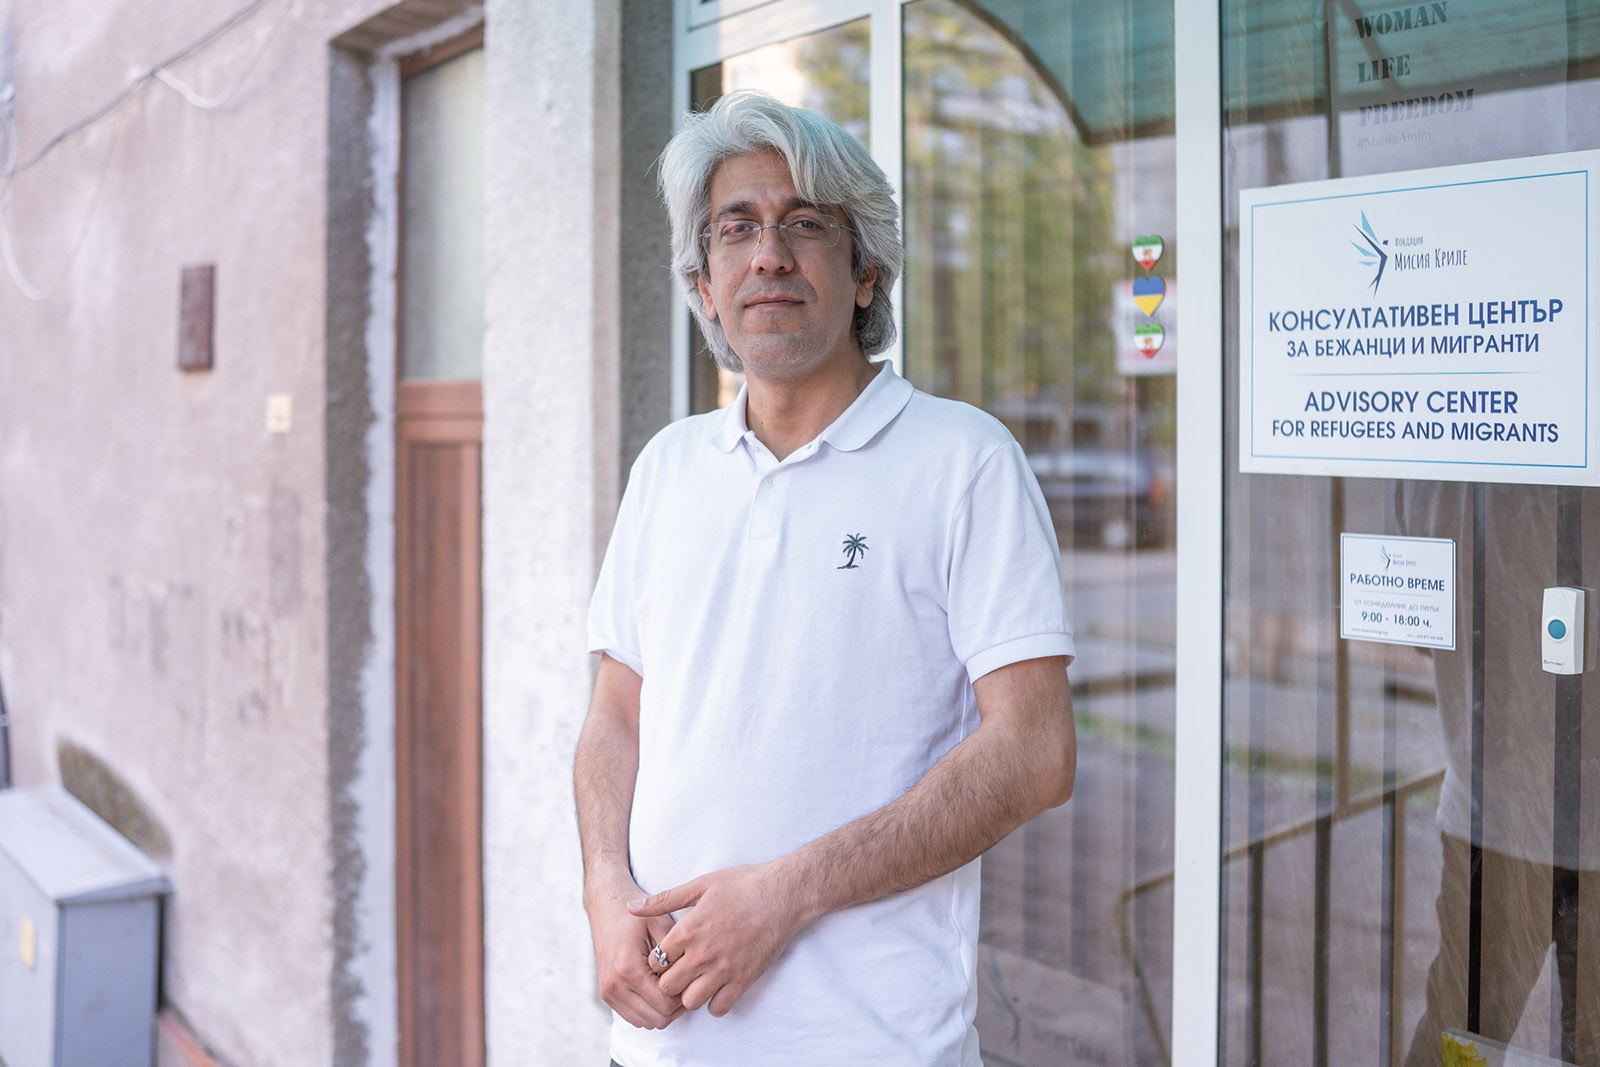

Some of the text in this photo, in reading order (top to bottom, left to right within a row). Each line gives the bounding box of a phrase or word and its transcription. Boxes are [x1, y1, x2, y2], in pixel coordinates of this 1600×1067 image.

[1355, 2, 1448, 39] WOMAN
[1357, 54, 1410, 83] LIFE
[1359, 89, 1475, 127] FREEDOM
[1269, 298, 1563, 331] КОНСУЛТАТИВЕН ЦЕНТЪР
[1287, 334, 1539, 358] ЗА БЕЖАНЦИ И МИГРАНТИ
[1304, 390, 1518, 414] ADVISORY CENTER
[1272, 420, 1559, 443] FOR REFUGEES AND MIGRANTS
[1350, 573, 1445, 591] РАБОТНО ВРЕМЕ
[1361, 612, 1382, 623] 9:00
[1394, 614, 1419, 626] 18:00
